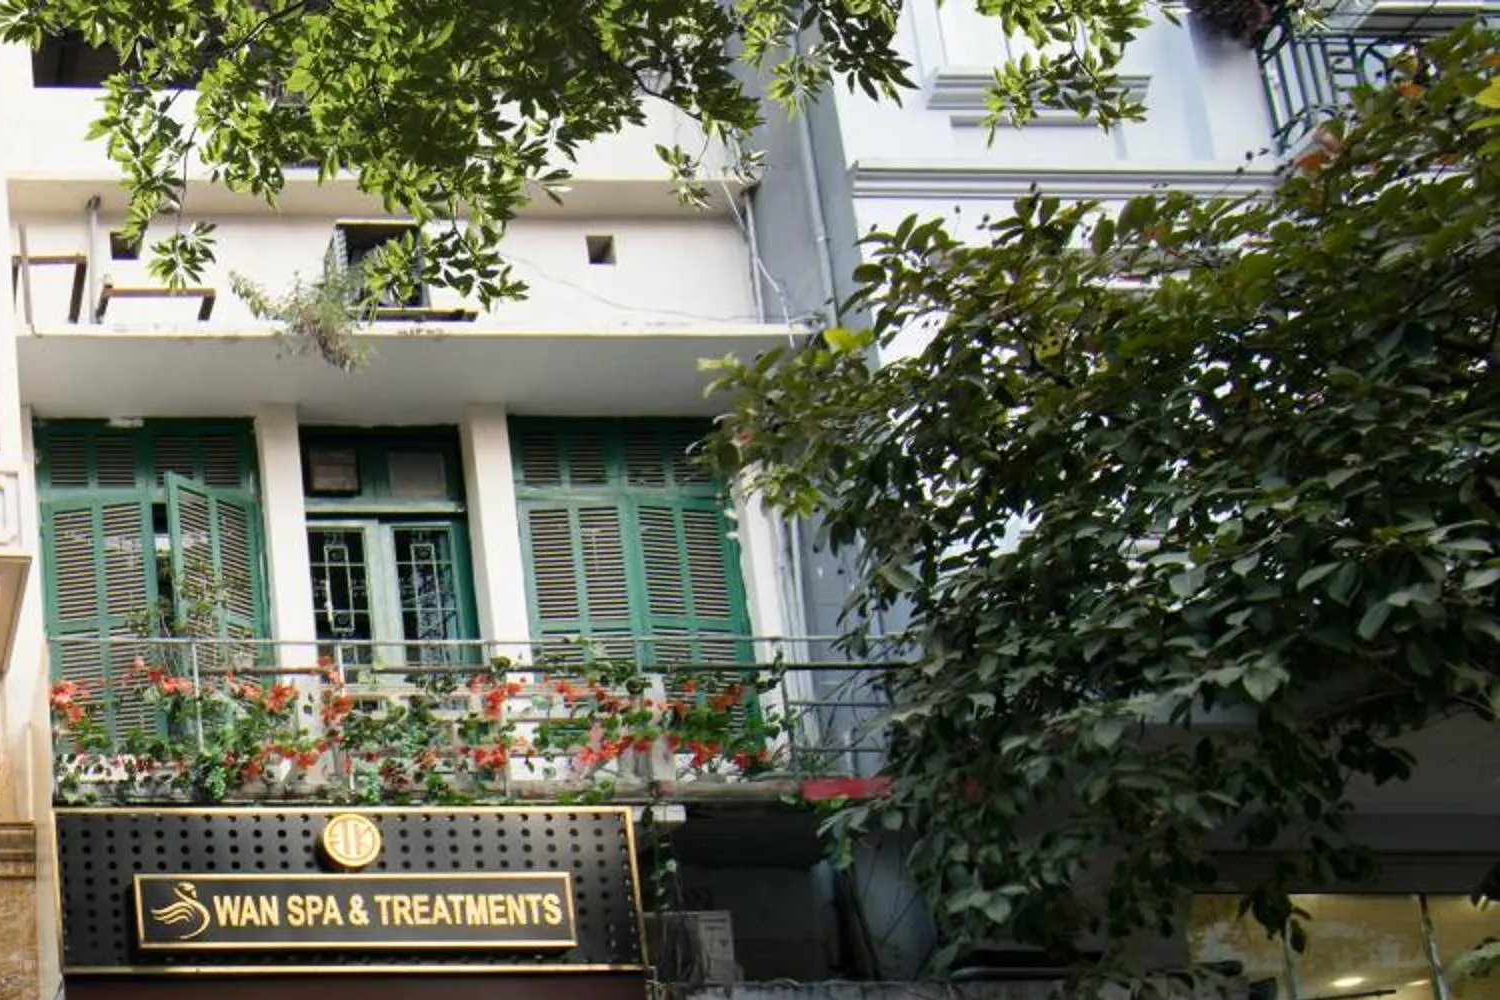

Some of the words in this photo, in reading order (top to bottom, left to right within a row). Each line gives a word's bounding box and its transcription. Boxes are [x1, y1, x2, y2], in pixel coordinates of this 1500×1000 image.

[286, 894, 344, 927] SPA
[349, 893, 370, 926] &
[374, 892, 563, 926] TREATMENTS
